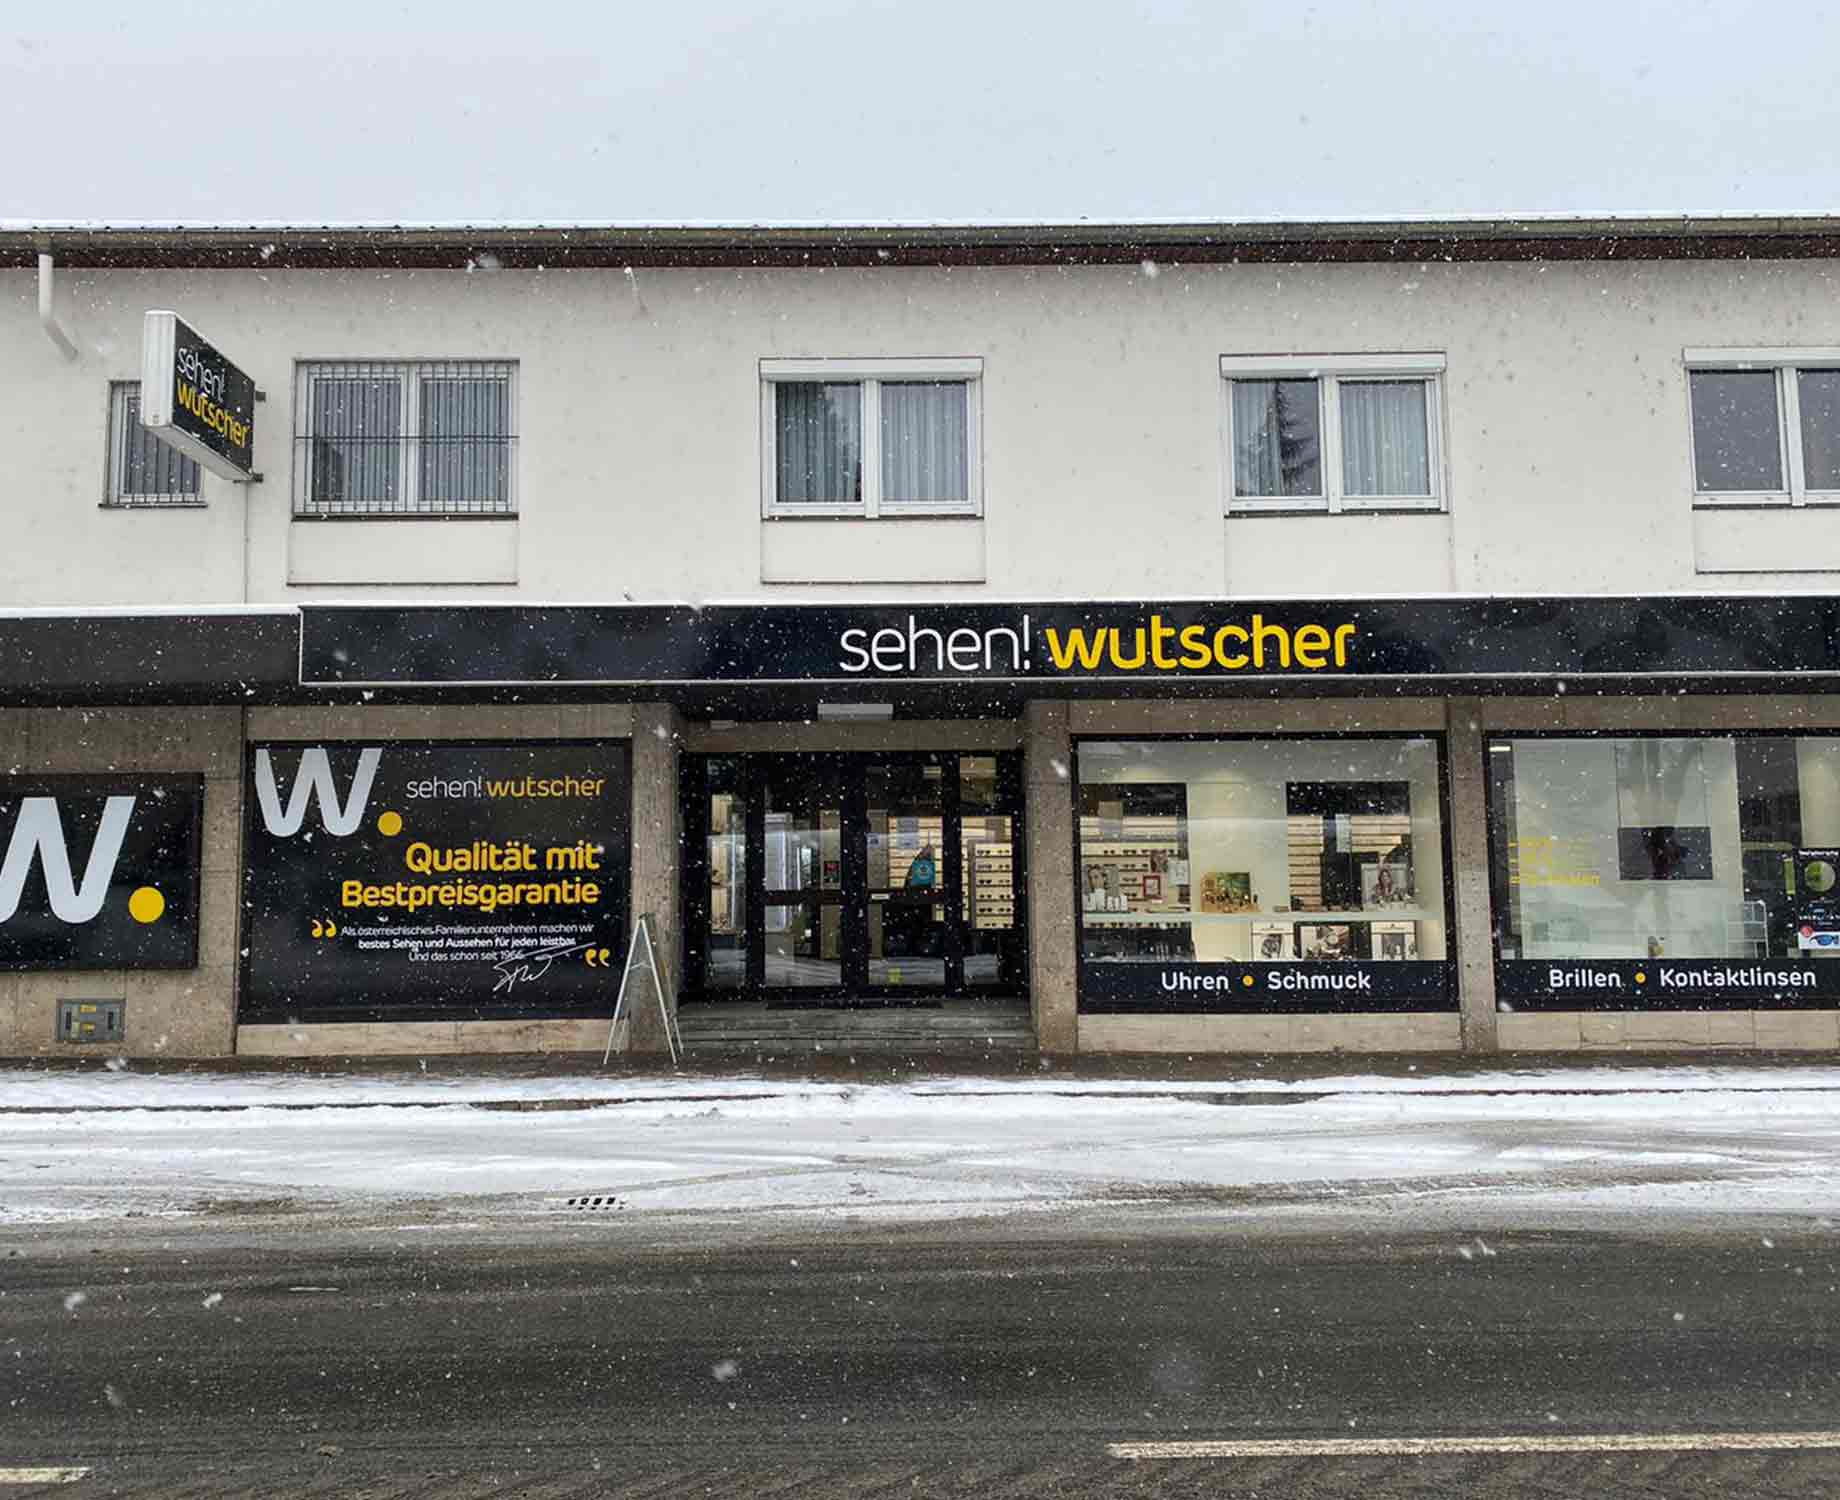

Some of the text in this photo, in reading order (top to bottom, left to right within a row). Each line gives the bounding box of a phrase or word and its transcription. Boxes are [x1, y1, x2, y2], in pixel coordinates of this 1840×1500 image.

[177, 347, 226, 403] sehen!
[176, 377, 249, 448] wutscher
[839, 614, 1356, 673] sehen! wutscher
[405, 775, 605, 799] sehen! wutscher
[405, 839, 602, 876] Qualität mit
[341, 876, 601, 913] Bestpreisgarantie
[408, 950, 430, 962] Und
[430, 951, 449, 961] das
[449, 950, 479, 961] schon
[425, 938, 445, 949] und
[446, 938, 494, 948] Aussehen
[495, 936, 510, 948] für
[511, 936, 538, 949] jeden
[1161, 970, 1372, 991] Uhren Schmuck
[1549, 967, 1817, 988] Brillen Kontaktlinsen
